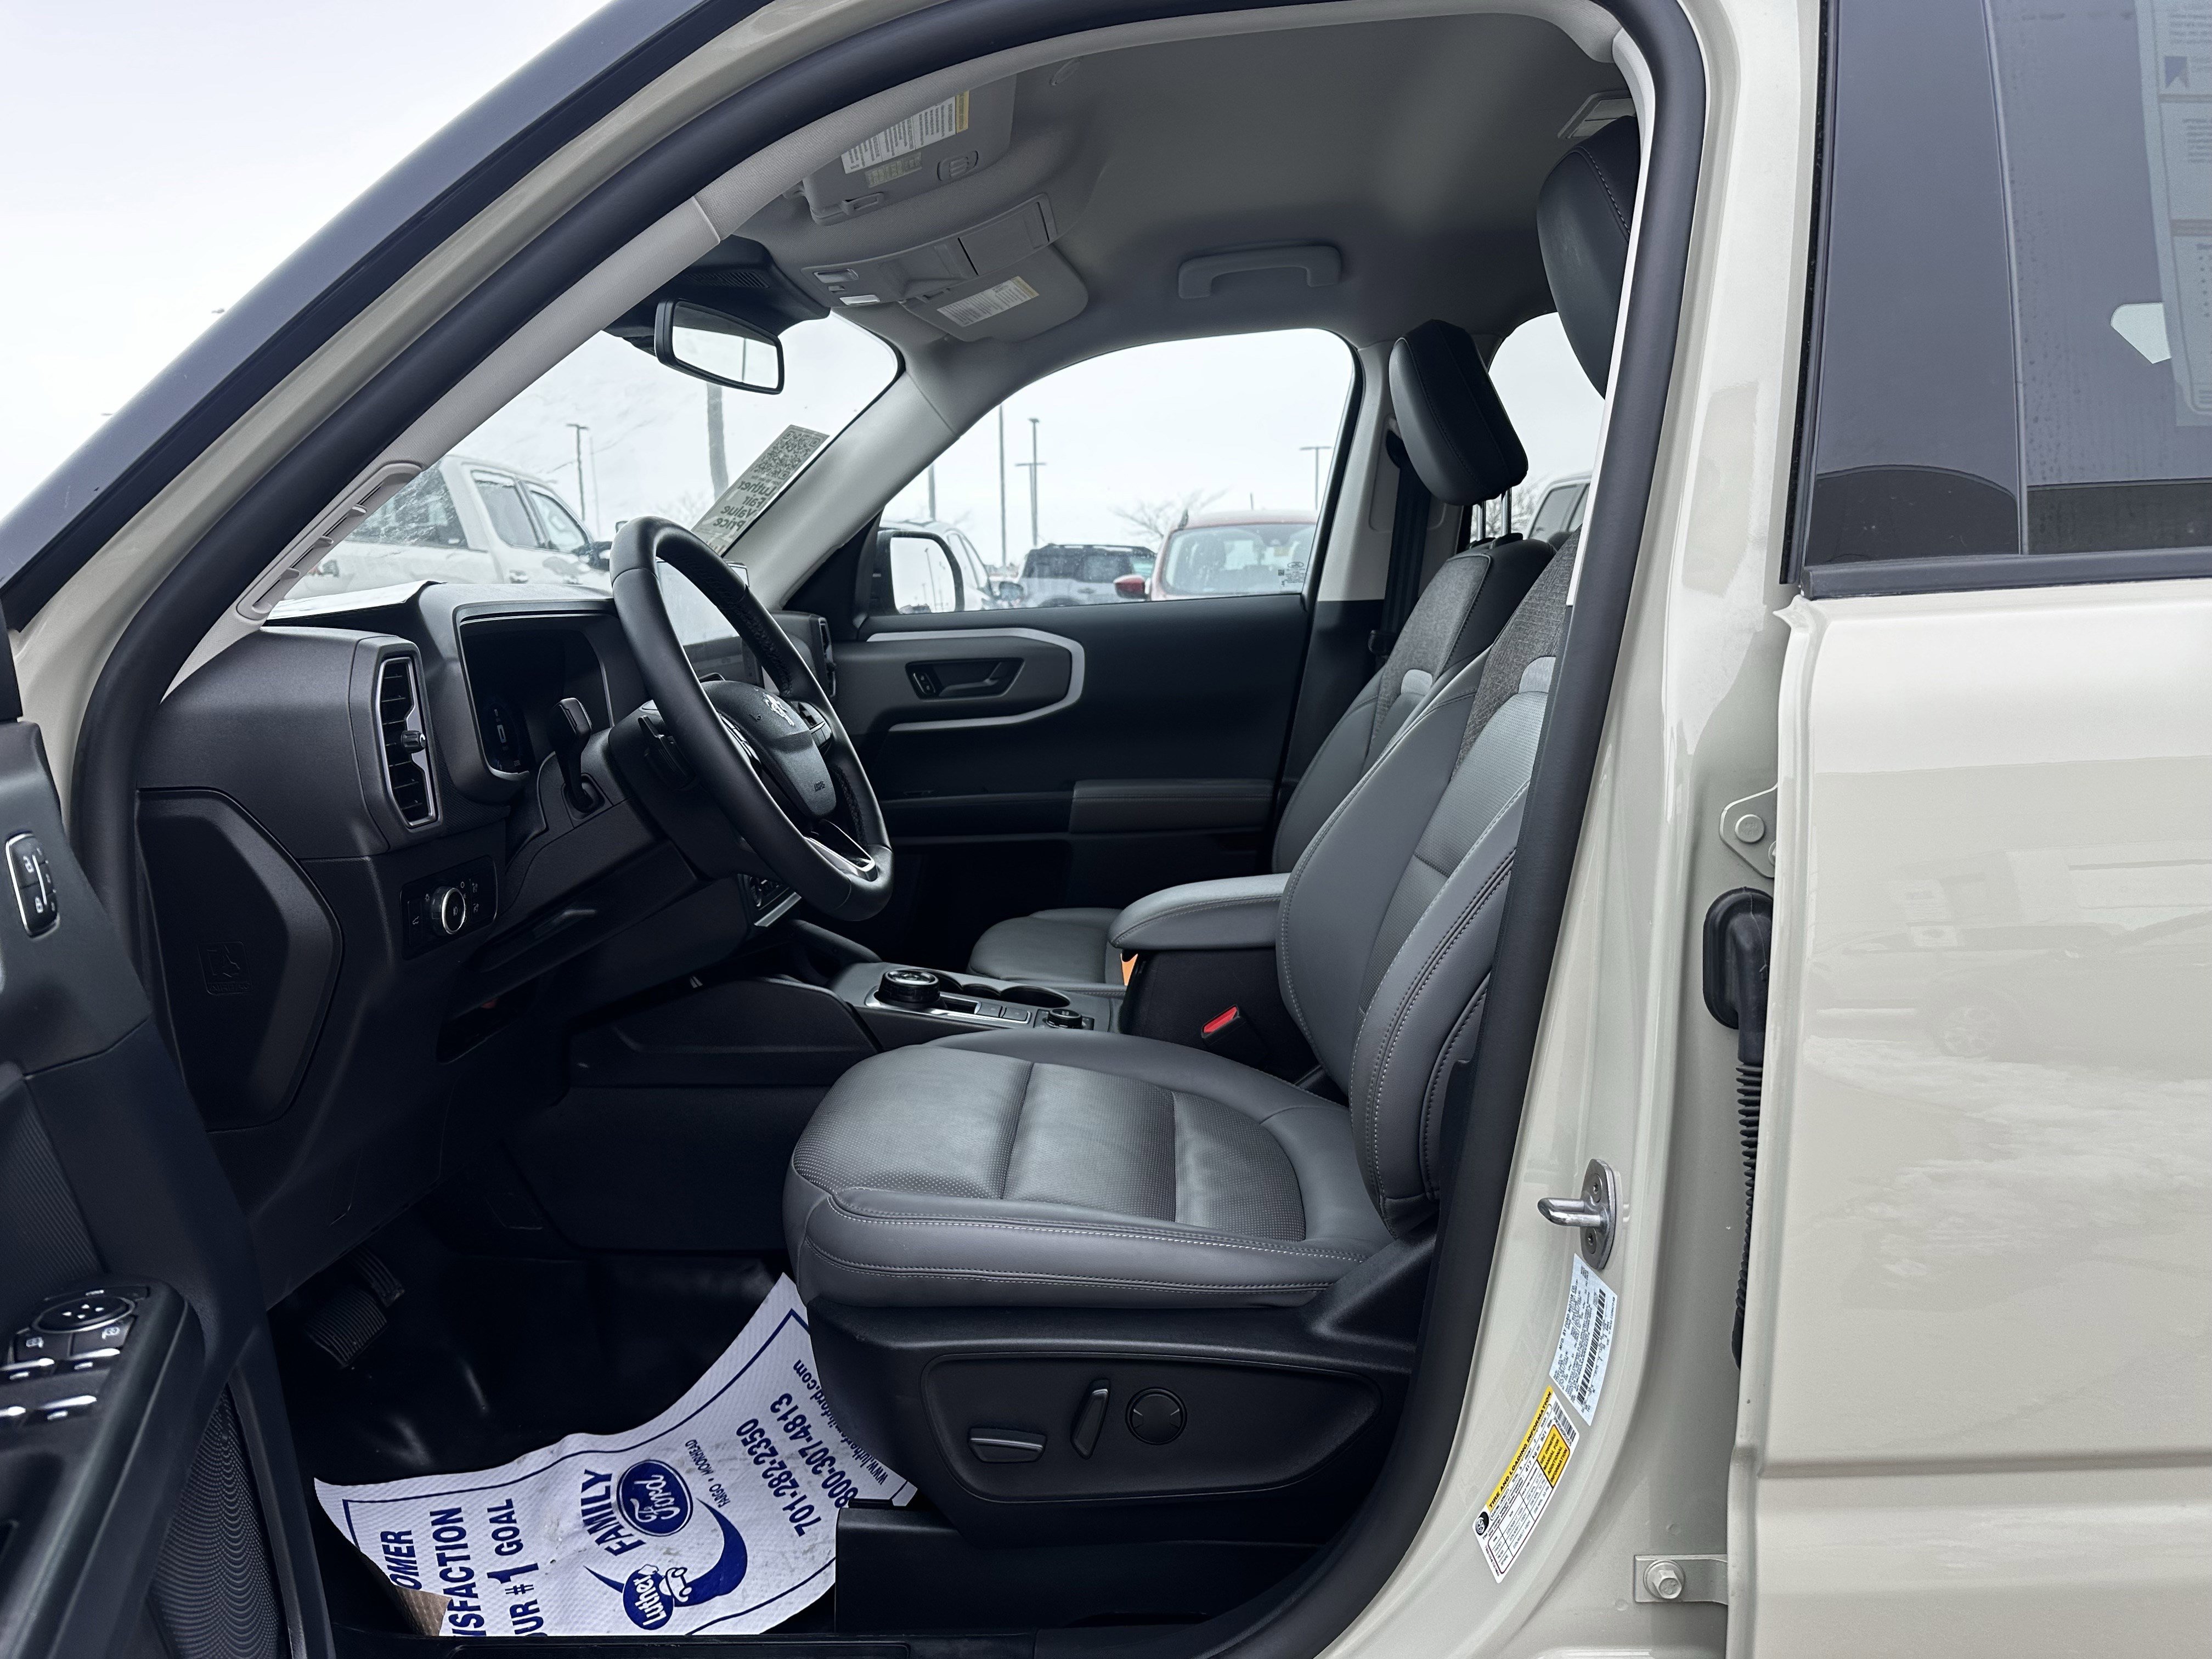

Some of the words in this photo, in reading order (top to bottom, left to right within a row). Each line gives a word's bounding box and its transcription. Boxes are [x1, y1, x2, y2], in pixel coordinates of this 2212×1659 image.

[1562, 1328, 1566, 1336] BY
[685, 1440, 713, 1476] MOORHEAD
[770, 1393, 858, 1509] 800-307-4813
[1488, 1491, 1500, 1509] TIRE
[1499, 1475, 1510, 1492] AND
[1509, 1442, 1527, 1475] LOADING
[1526, 1391, 1551, 1442] INFORMATION
[1543, 1449, 1554, 1471] MANUAL
[1544, 1432, 1555, 1454] OWNERS
[1547, 1444, 1562, 1475] ADDITIONAL
[736, 1419, 821, 1537] 701-282-2350
[1550, 1448, 1567, 1482] INFORMATION
[581, 1470, 646, 1556] FAMILY
[630, 1475, 680, 1522] Ford
[709, 1484, 730, 1508] FARGO
[1491, 1504, 1500, 1517] SEATING
[487, 1498, 524, 1556] GOAL
[1487, 1514, 1499, 1533] combined
[1499, 1501, 1508, 1515] weight
[510, 1599, 548, 1637] UR
[633, 1575, 667, 1626] Luther
